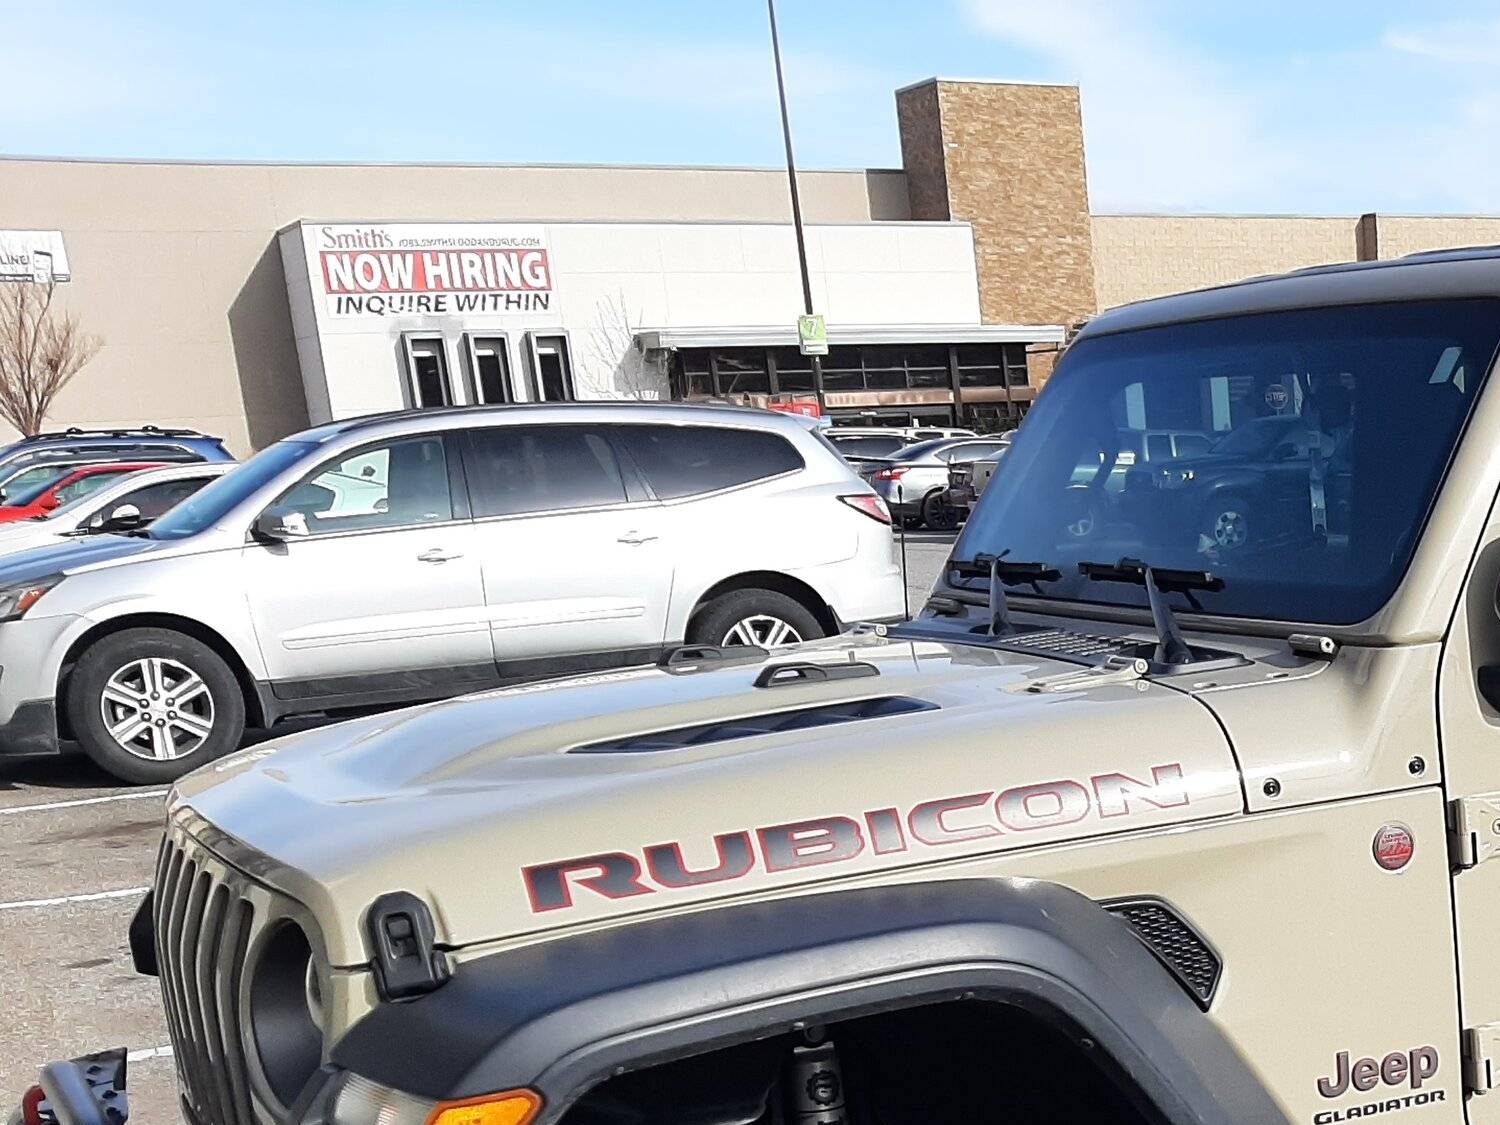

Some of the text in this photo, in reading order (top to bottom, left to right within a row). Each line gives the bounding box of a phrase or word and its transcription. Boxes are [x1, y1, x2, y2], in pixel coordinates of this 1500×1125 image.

[321, 226, 394, 249] Smith's
[324, 250, 549, 292] NOW HIRING
[336, 292, 550, 316] INQUIRE WITHIN
[804, 318, 818, 338] 7
[520, 763, 1190, 914] RUBICON
[1316, 1045, 1439, 1098] Jeep
[1313, 1089, 1446, 1125] GLADIATOR
